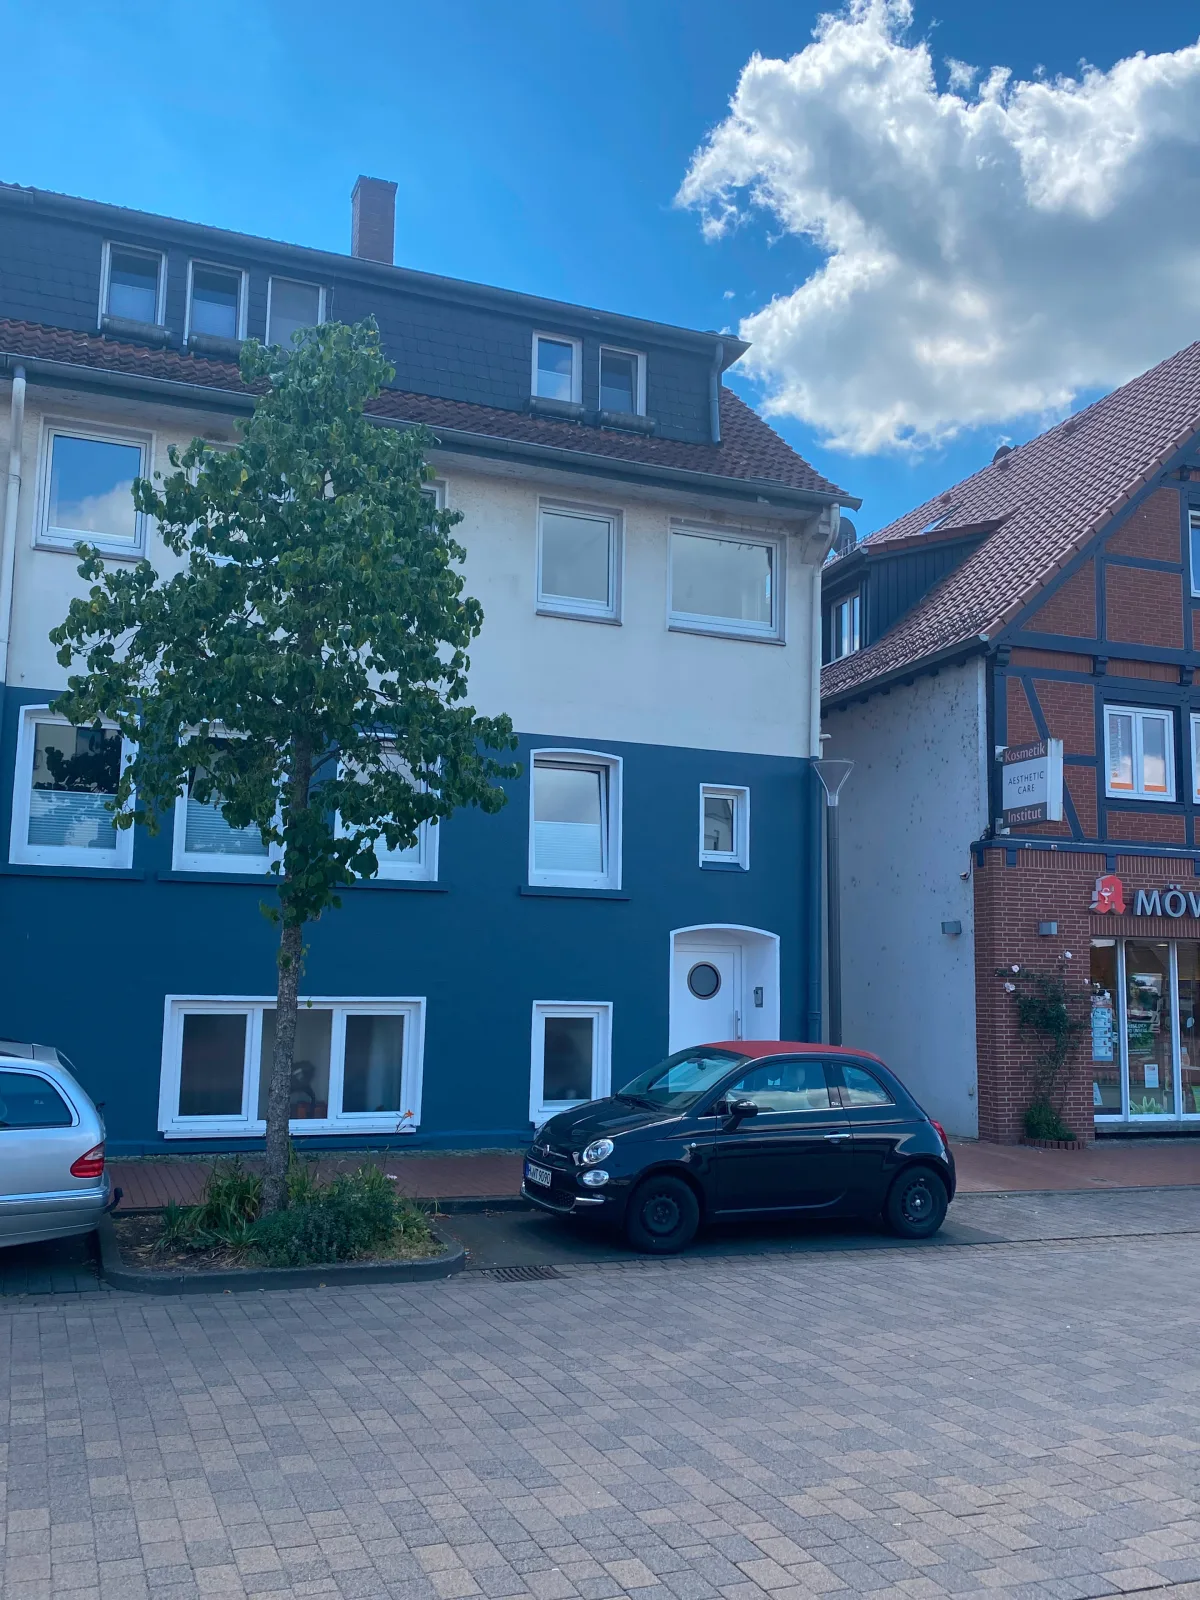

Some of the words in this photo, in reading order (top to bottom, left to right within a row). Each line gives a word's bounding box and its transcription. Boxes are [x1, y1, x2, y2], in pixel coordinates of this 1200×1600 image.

[1005, 742, 1045, 763] Kosmetik
[1008, 770, 1045, 786] AESTHETIC
[1017, 783, 1035, 795] CARE
[1008, 808, 1042, 823] Institut
